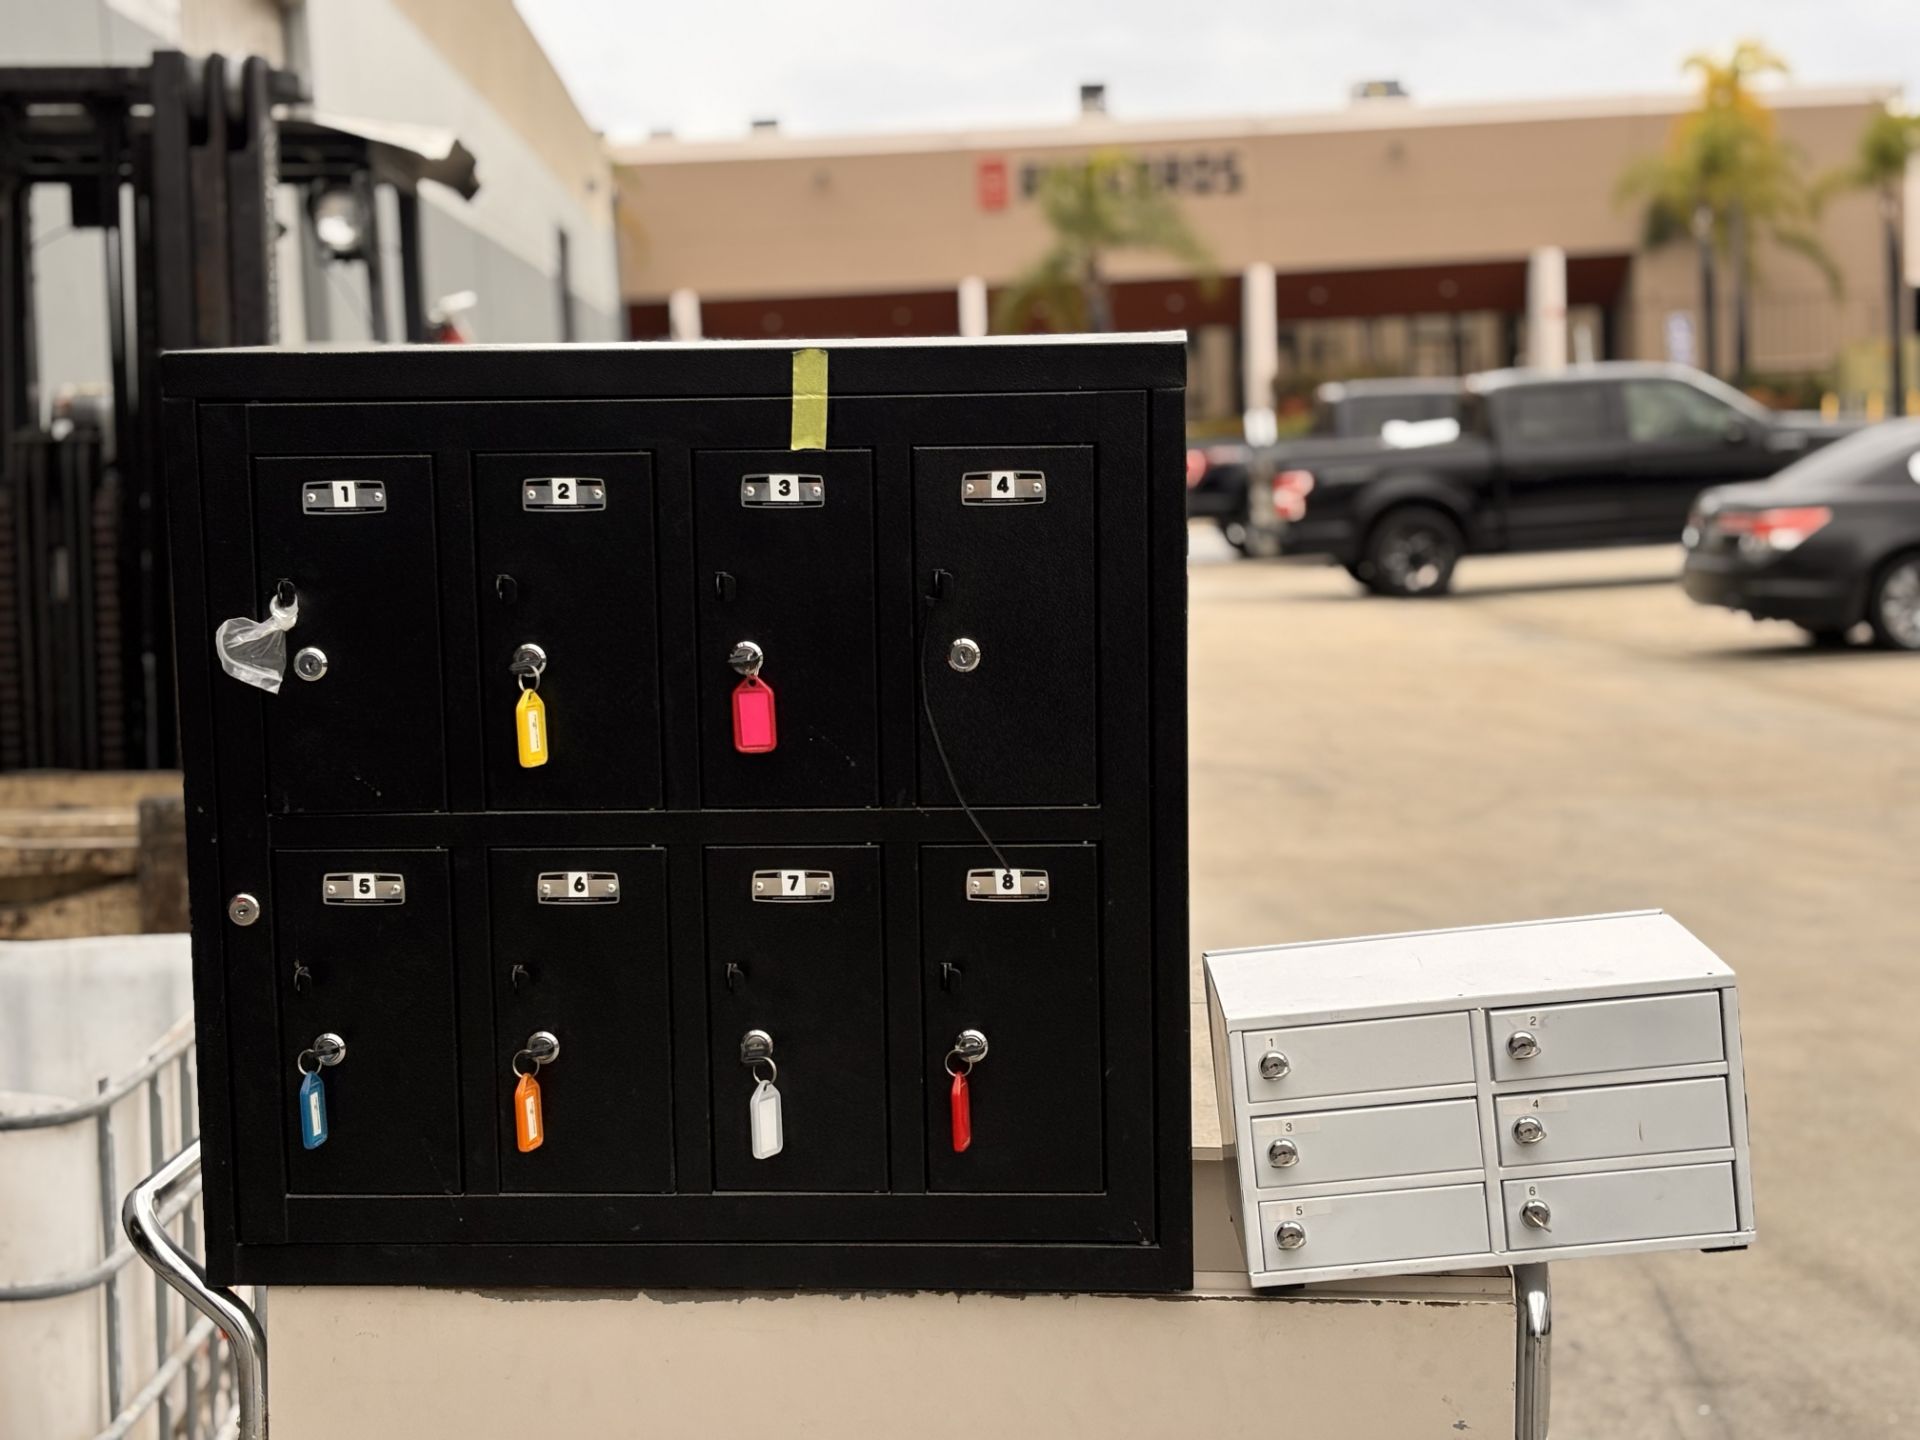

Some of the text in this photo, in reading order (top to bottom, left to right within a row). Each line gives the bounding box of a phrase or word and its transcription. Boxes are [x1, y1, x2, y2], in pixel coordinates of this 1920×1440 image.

[558, 483, 570, 500] 2
[778, 480, 791, 496] 3
[997, 476, 1009, 493] 4
[341, 486, 349, 502] 1
[359, 879, 370, 895] 5
[574, 876, 585, 892] 6
[788, 875, 799, 890] 7
[1002, 874, 1014, 890] 8
[1530, 1016, 1537, 1026] 2
[1269, 1038, 1274, 1047] 1
[1532, 1099, 1539, 1109] 4
[1285, 1122, 1293, 1132] 3
[1529, 1186, 1536, 1196] 6
[1296, 1206, 1303, 1216] 5
